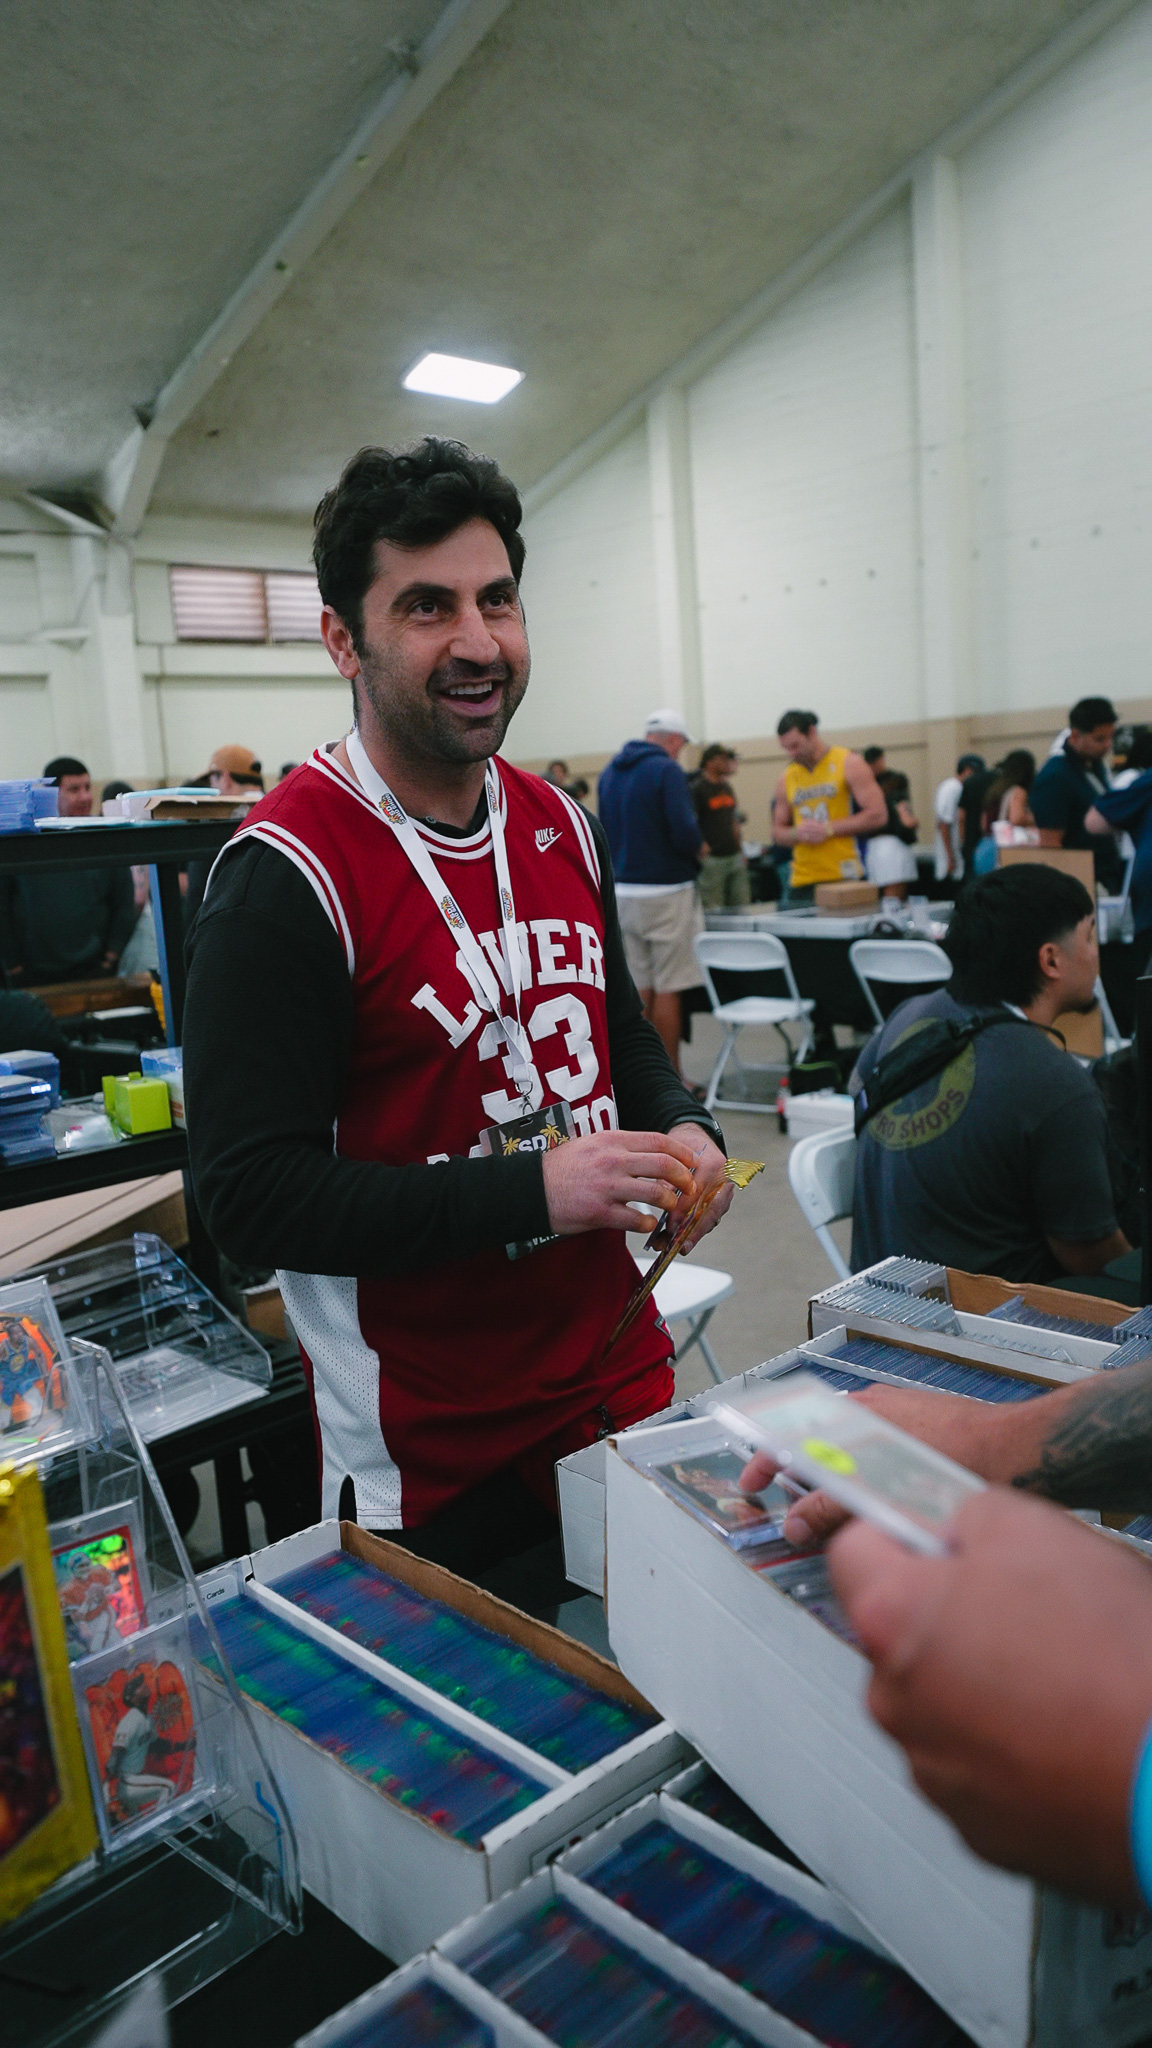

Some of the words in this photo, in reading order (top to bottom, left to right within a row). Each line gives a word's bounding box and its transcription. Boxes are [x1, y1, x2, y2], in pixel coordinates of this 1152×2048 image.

[535, 827, 555, 844] NIKE
[477, 993, 599, 1124] 33
[900, 1088, 966, 1140] SHOPS
[518, 1134, 547, 1151] SD
